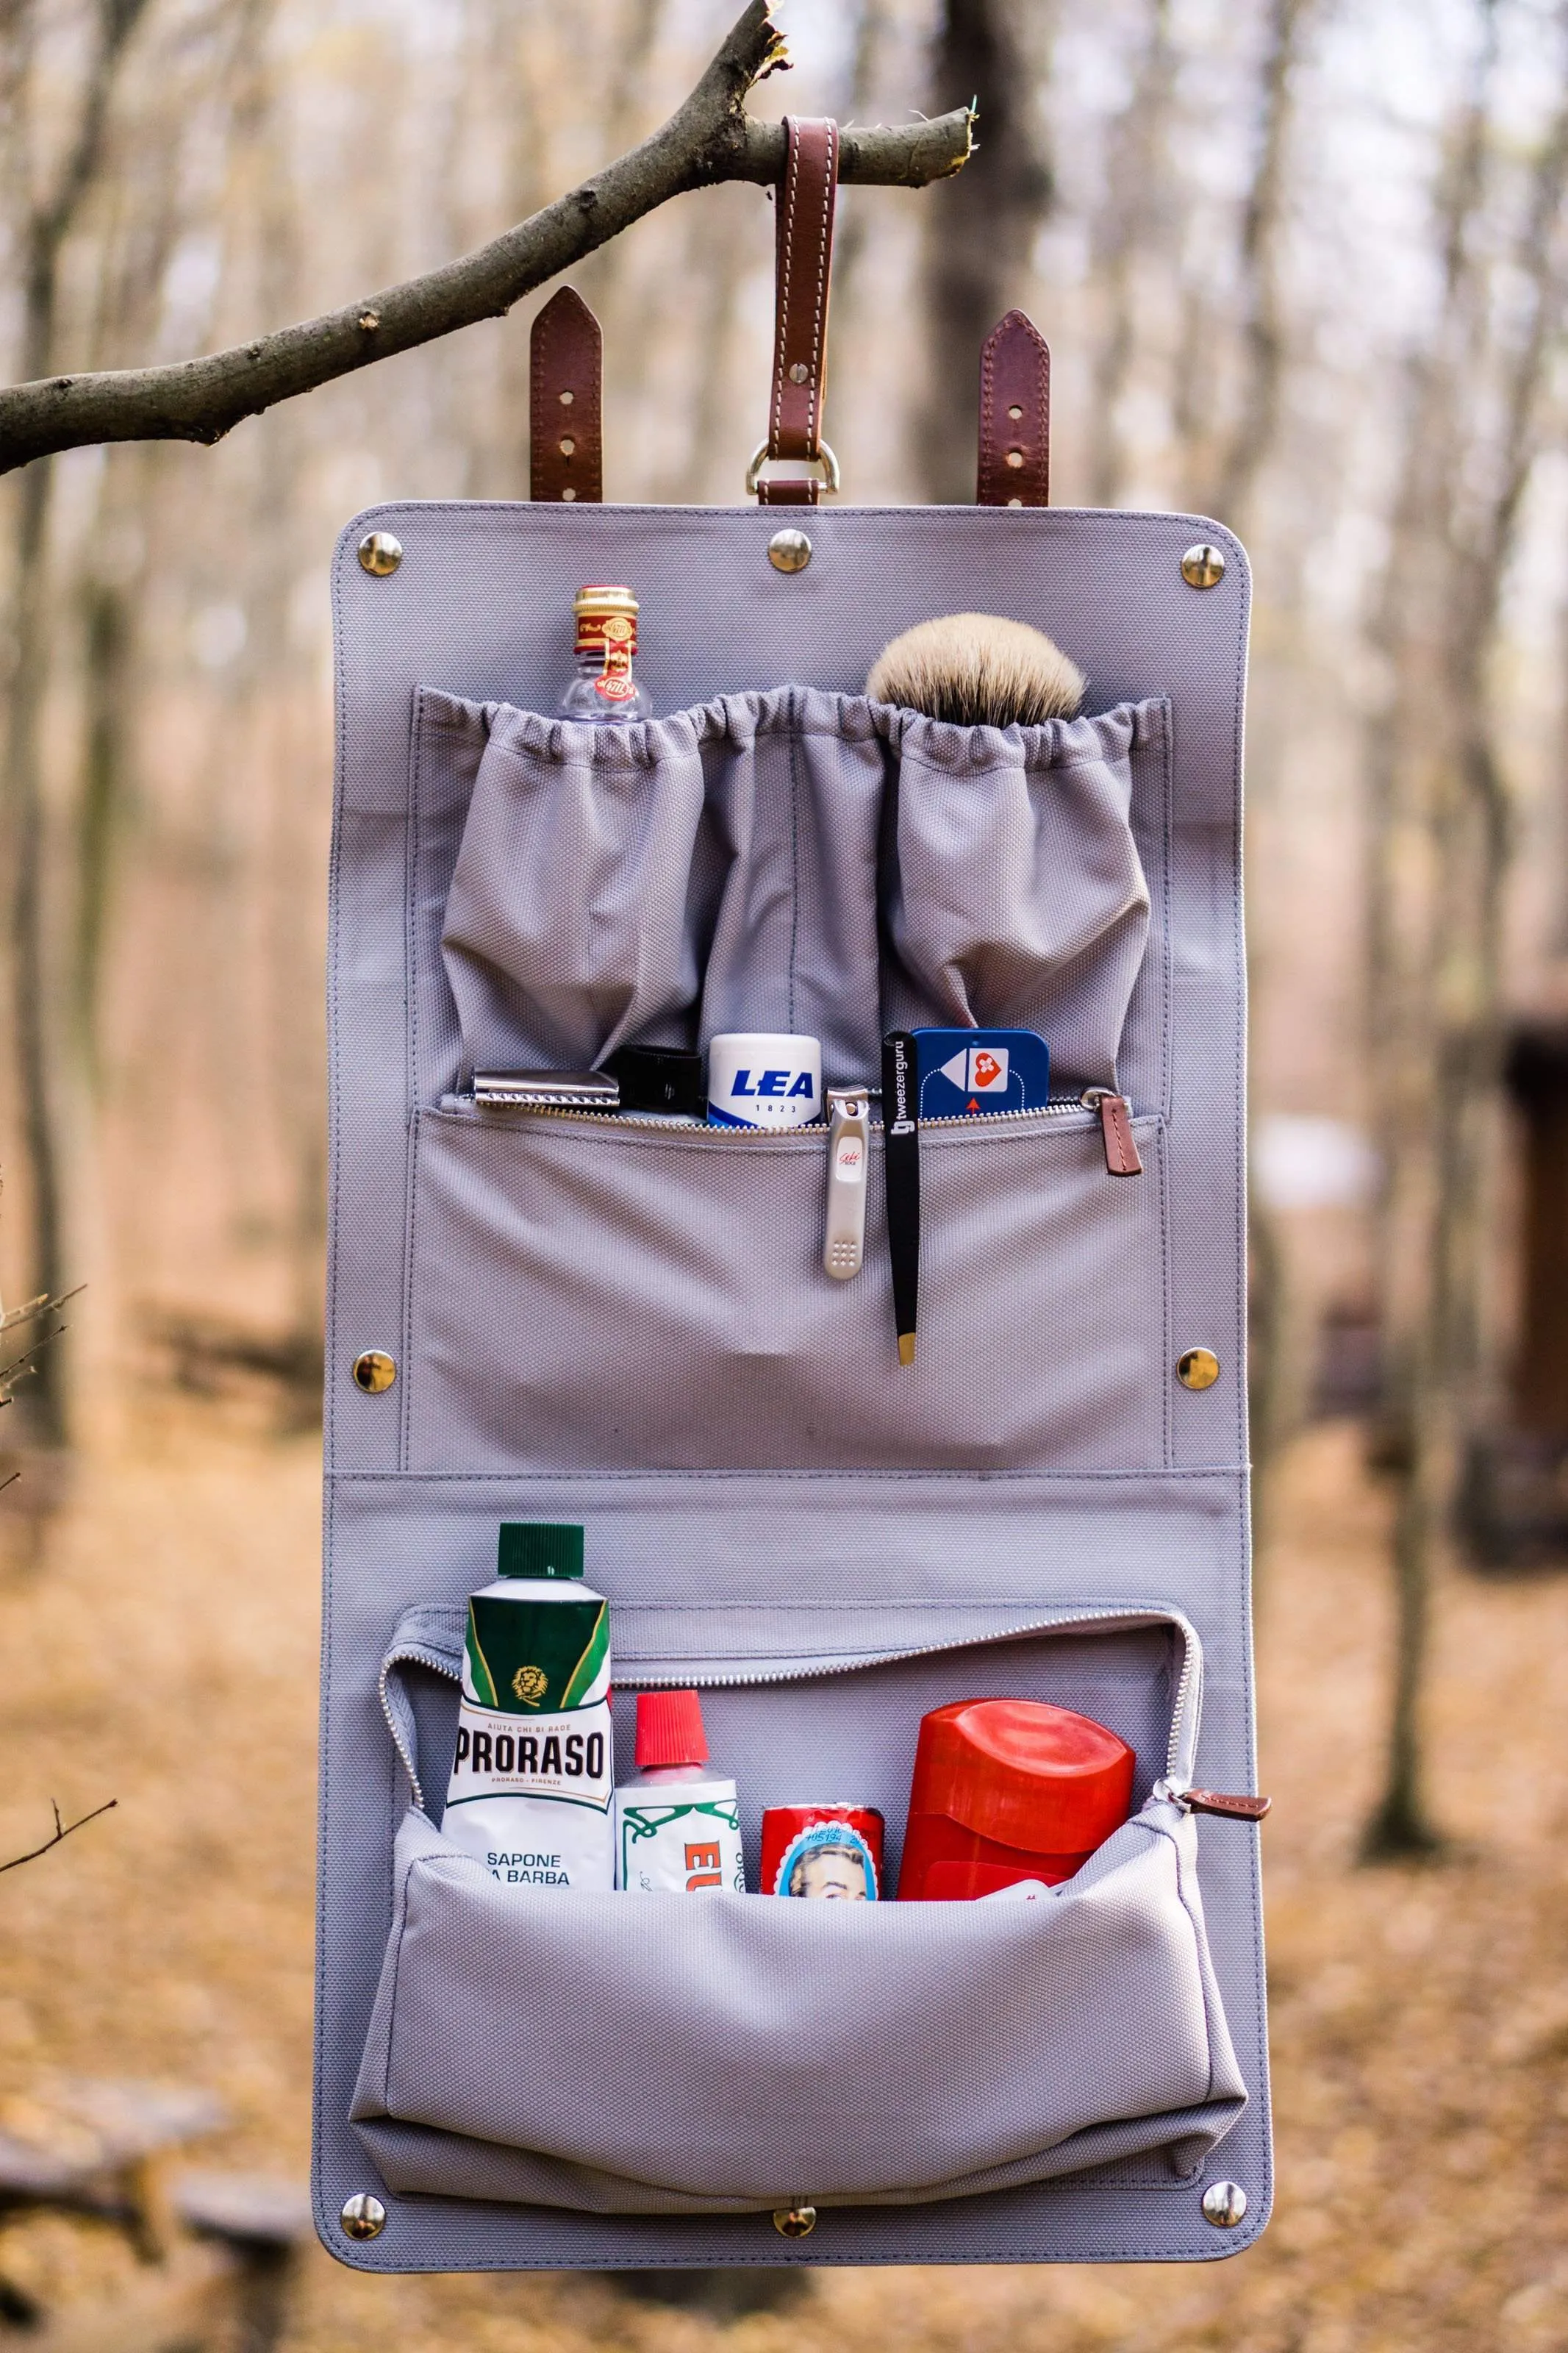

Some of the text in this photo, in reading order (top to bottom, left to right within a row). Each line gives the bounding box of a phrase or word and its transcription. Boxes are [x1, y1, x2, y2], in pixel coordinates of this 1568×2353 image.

[731, 1070, 813, 1099] LEA
[895, 1040, 909, 1120] tweezerguru
[487, 1723, 512, 1732] AIUTA
[548, 1724, 571, 1732] RADE
[454, 1726, 604, 1779] PRORASO
[531, 1778, 562, 1786] FIRENZE
[487, 1852, 561, 1868] SAPONE
[507, 1870, 570, 1885] BARBA
